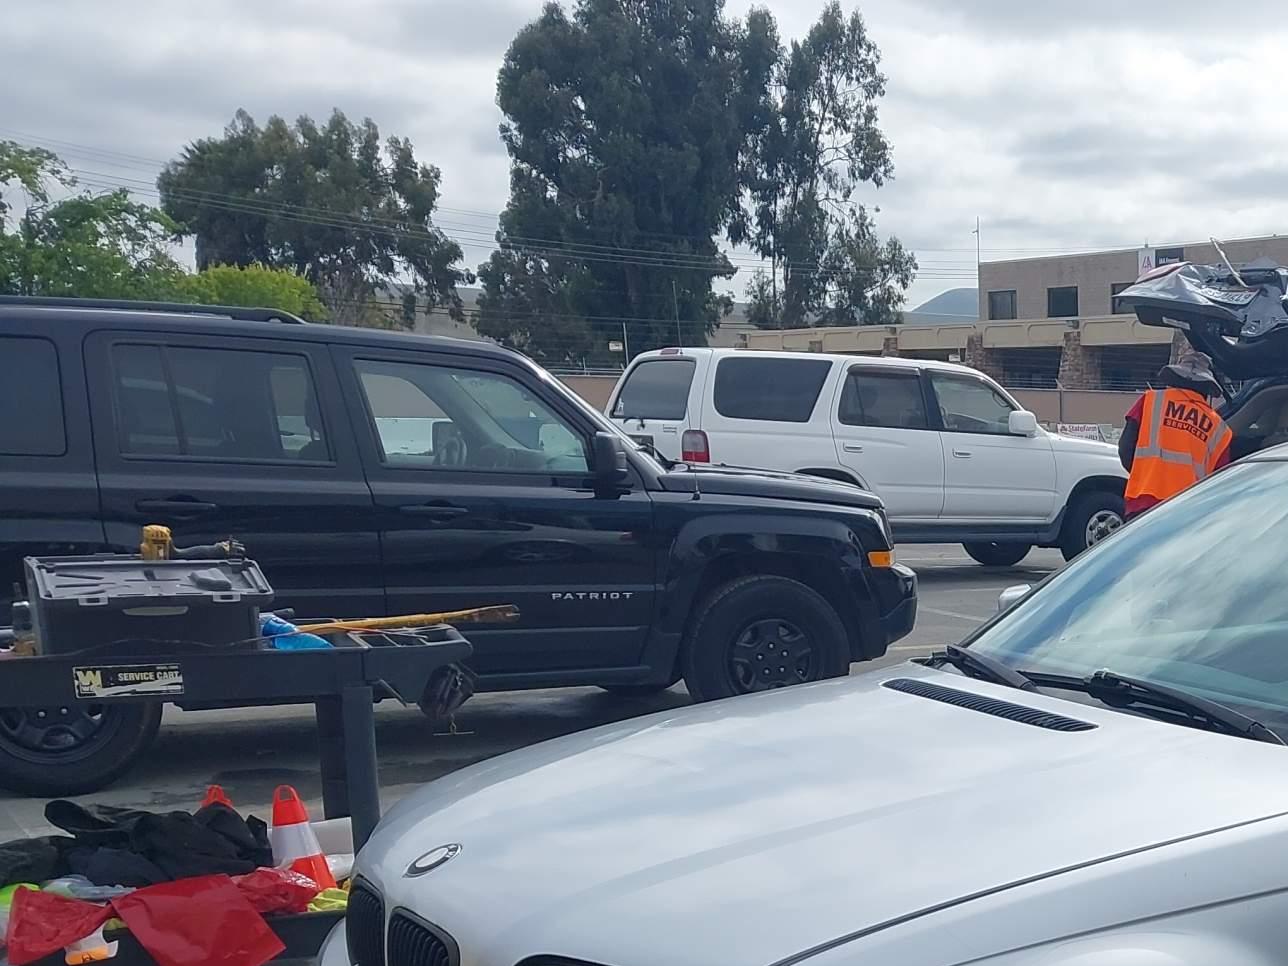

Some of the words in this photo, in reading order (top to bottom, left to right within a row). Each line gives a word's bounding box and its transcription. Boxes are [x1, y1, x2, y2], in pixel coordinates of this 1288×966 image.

[1165, 401, 1213, 433] MAD
[551, 592, 633, 600] PATRIOT
[117, 671, 155, 682] SERVICE
[156, 670, 180, 681] CART
